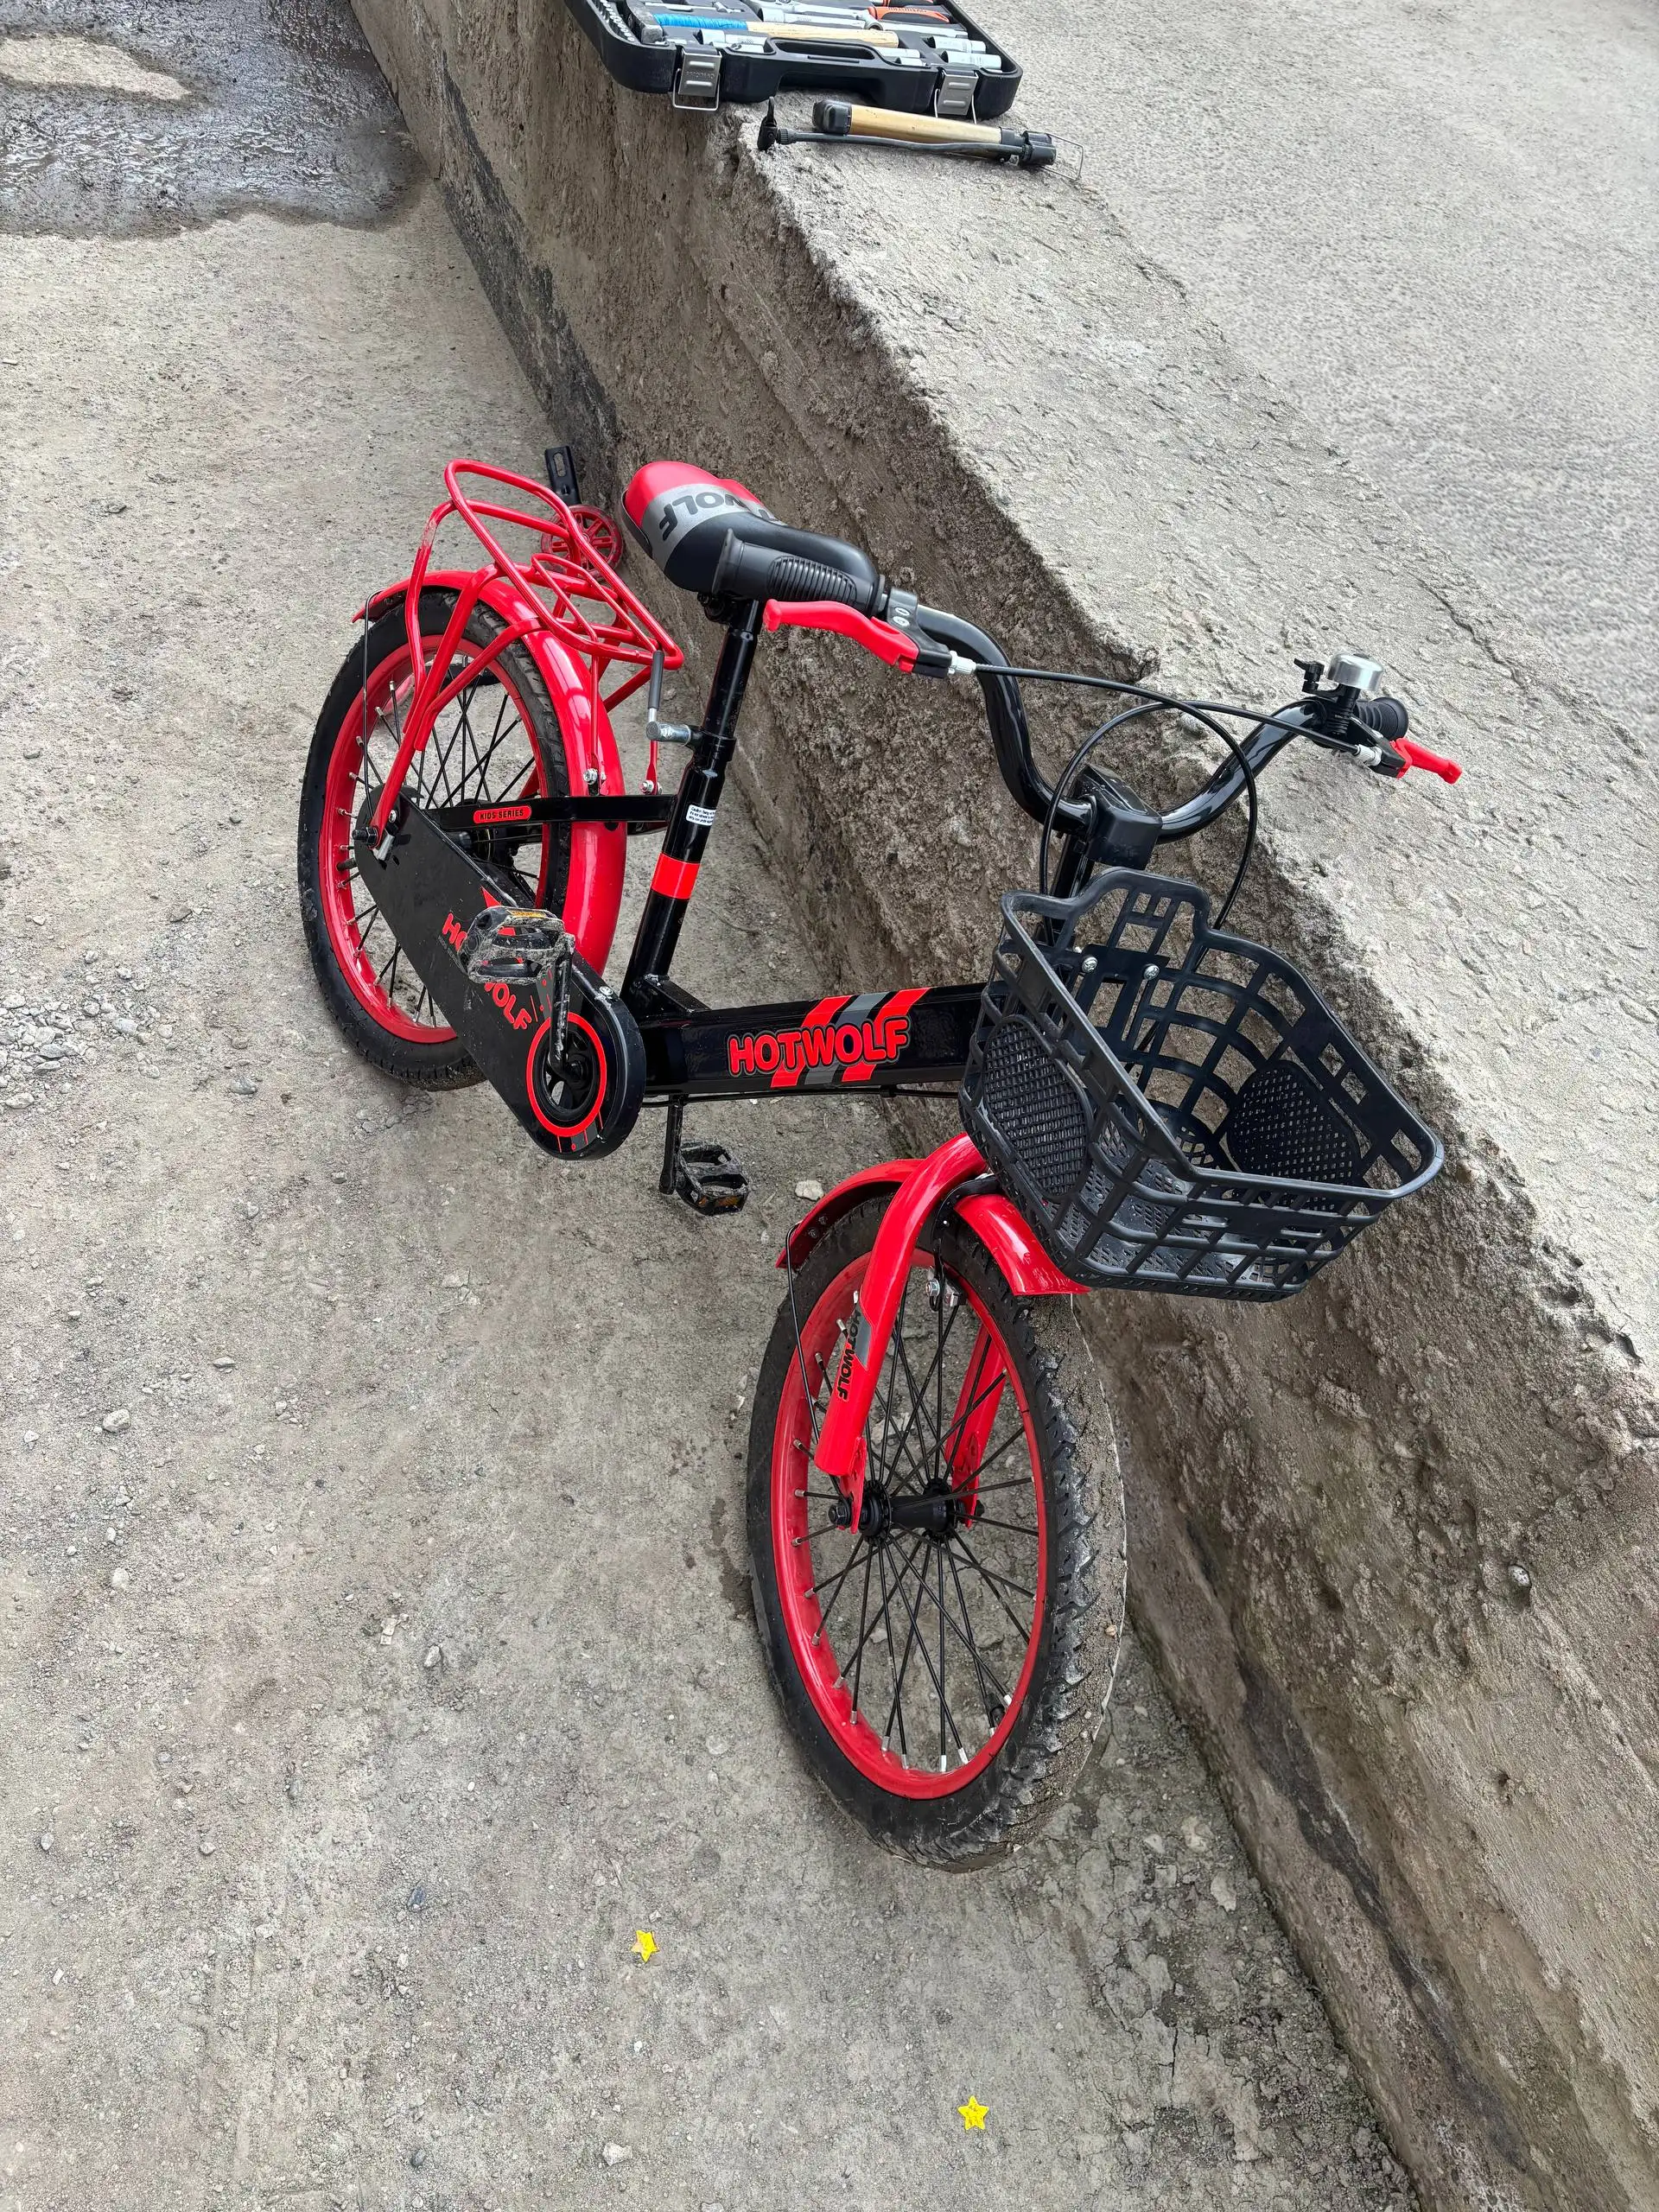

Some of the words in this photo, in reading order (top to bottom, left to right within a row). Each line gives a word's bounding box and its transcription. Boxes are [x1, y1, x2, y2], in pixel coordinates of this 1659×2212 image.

[480, 810, 496, 821] KIDS
[498, 809, 524, 819] SERIES
[728, 1017, 910, 1075] HOTWOLF
